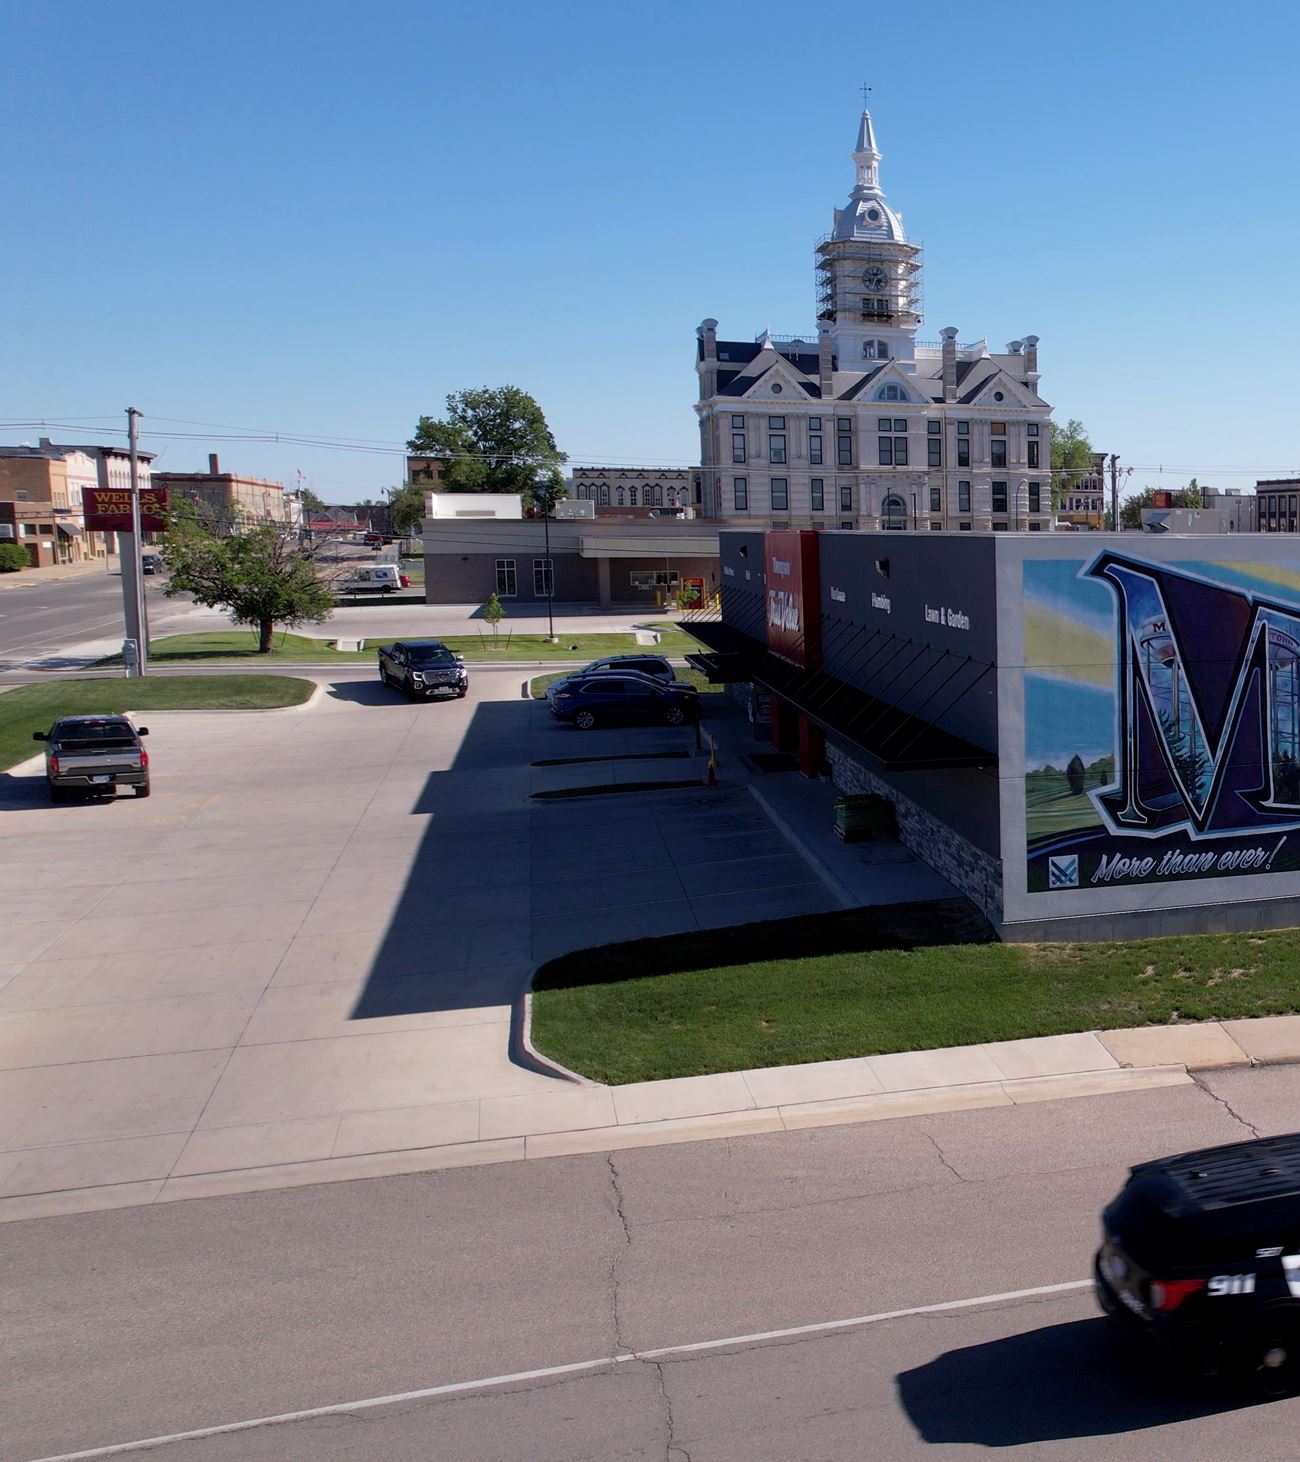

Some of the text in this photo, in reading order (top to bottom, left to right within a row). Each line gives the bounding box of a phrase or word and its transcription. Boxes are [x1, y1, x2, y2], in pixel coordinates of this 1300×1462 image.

[94, 492, 157, 503] WELS
[96, 503, 156, 515] FARO
[924, 603, 970, 630] Lawn & Garden
[1090, 836, 1287, 883] More than ever!
[1207, 1272, 1256, 1297] 911
